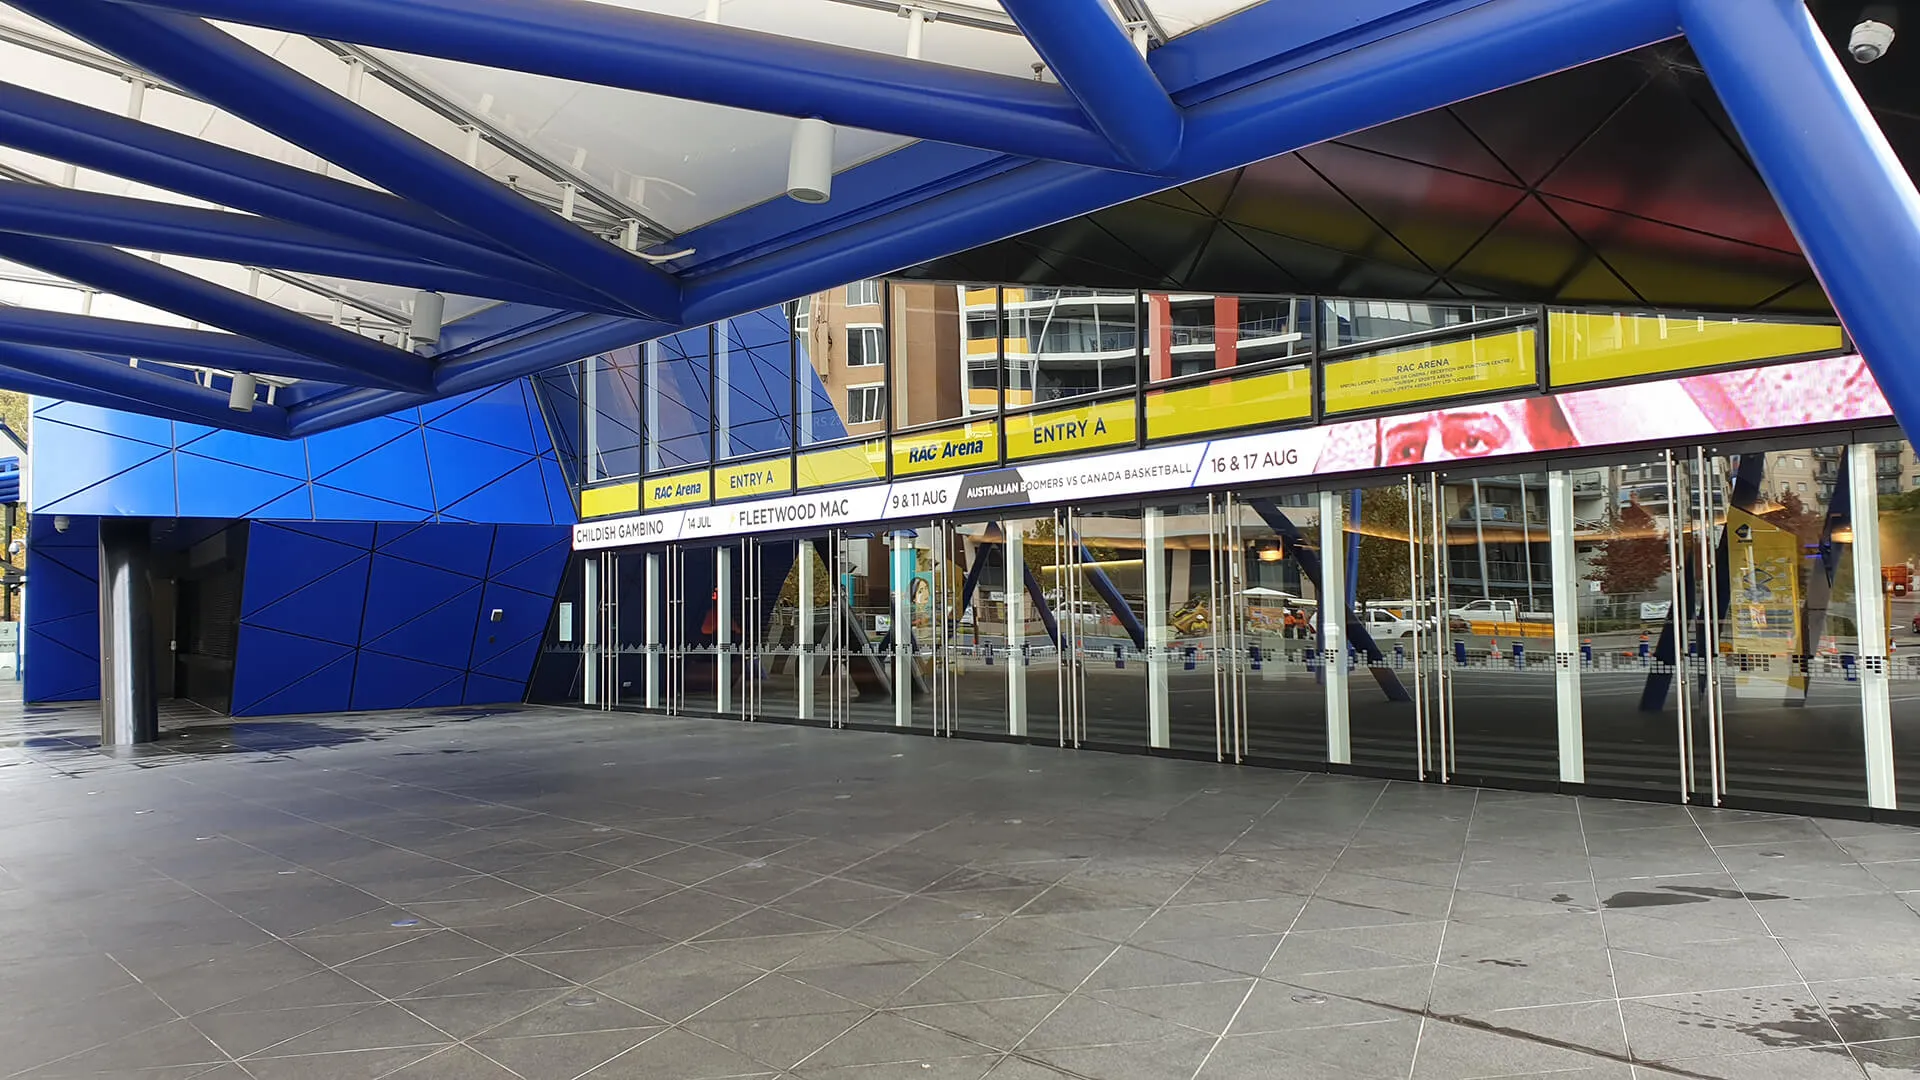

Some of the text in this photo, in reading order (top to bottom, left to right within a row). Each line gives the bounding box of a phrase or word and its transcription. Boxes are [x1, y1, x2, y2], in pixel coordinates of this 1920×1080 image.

[1397, 358, 1450, 373] RAC ARENA
[1465, 361, 1490, 369] FUNCTION
[1034, 417, 1107, 444] ENTRY A
[908, 438, 983, 463] RAC Arena
[1211, 449, 1298, 473] 16 & 17 AUG
[730, 470, 774, 489] ENTRY A
[966, 463, 1192, 498] AUSTRALIAN BOOMERS VS CANADA BASKETBALL
[654, 481, 701, 500] RAC Arena
[892, 489, 947, 508] 9 & 11 AUG
[687, 516, 711, 529] 14 JUL
[739, 499, 849, 526] FLEETWOOD MAC
[576, 519, 664, 543] CHILDISH GAMBINO
